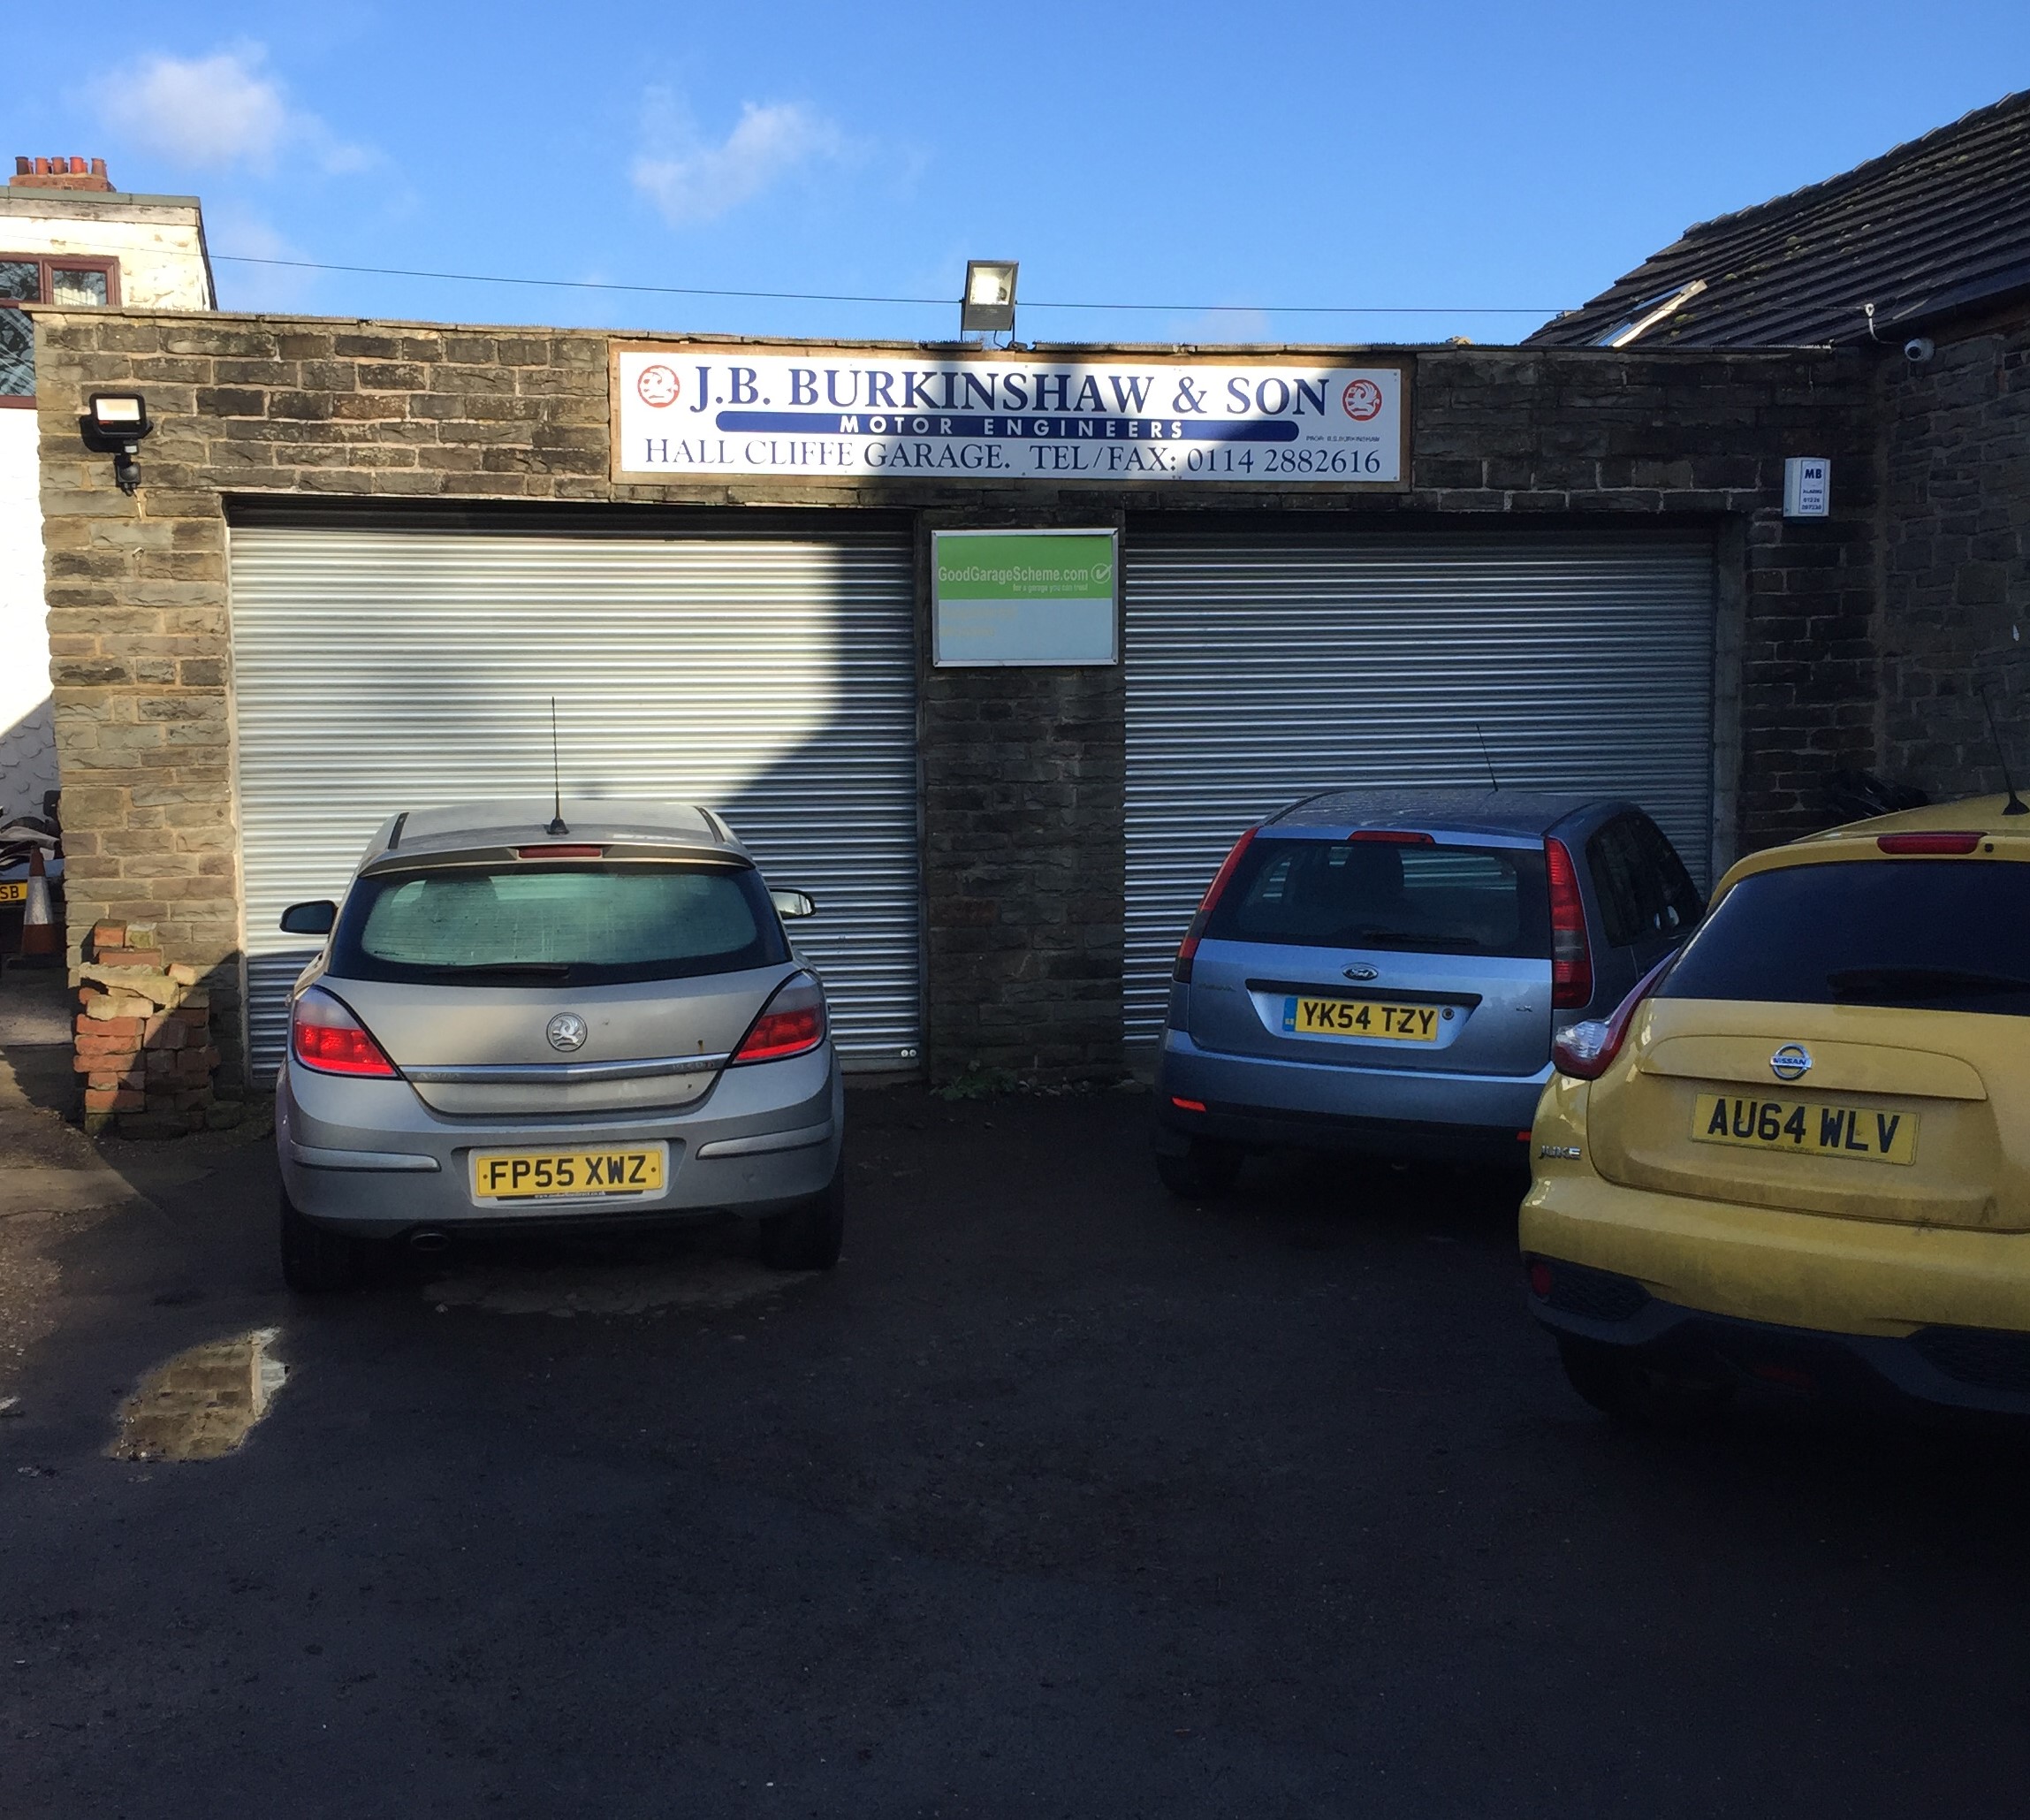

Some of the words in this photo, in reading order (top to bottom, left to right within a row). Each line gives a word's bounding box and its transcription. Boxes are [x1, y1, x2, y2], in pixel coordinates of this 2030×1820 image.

[690, 365, 771, 413] J.B.
[787, 367, 1154, 413] BURKINSHAW
[1172, 376, 1208, 415] &
[1227, 376, 1329, 415] SON
[840, 415, 953, 435] MOTOR
[984, 417, 1182, 438] ENGINEERS
[644, 438, 735, 464] HALL
[745, 439, 855, 467] CLIFFE
[863, 442, 1011, 469] GARAGE.
[1029, 445, 1177, 472] TEL/FAX:
[1187, 447, 1254, 474] 0114
[1264, 448, 1381, 474] 2882616
[1804, 468, 1822, 479] MB
[938, 566, 1089, 585] GoodGarageScheme.com
[1304, 1001, 1371, 1031] YK54
[1381, 1006, 1435, 1035] TZY
[1772, 1056, 1806, 1066] NISSAN
[1707, 1098, 1806, 1144] AU64
[1820, 1108, 1900, 1154] WLV
[490, 1157, 575, 1190] FP55
[584, 1154, 648, 1184] XWZ
